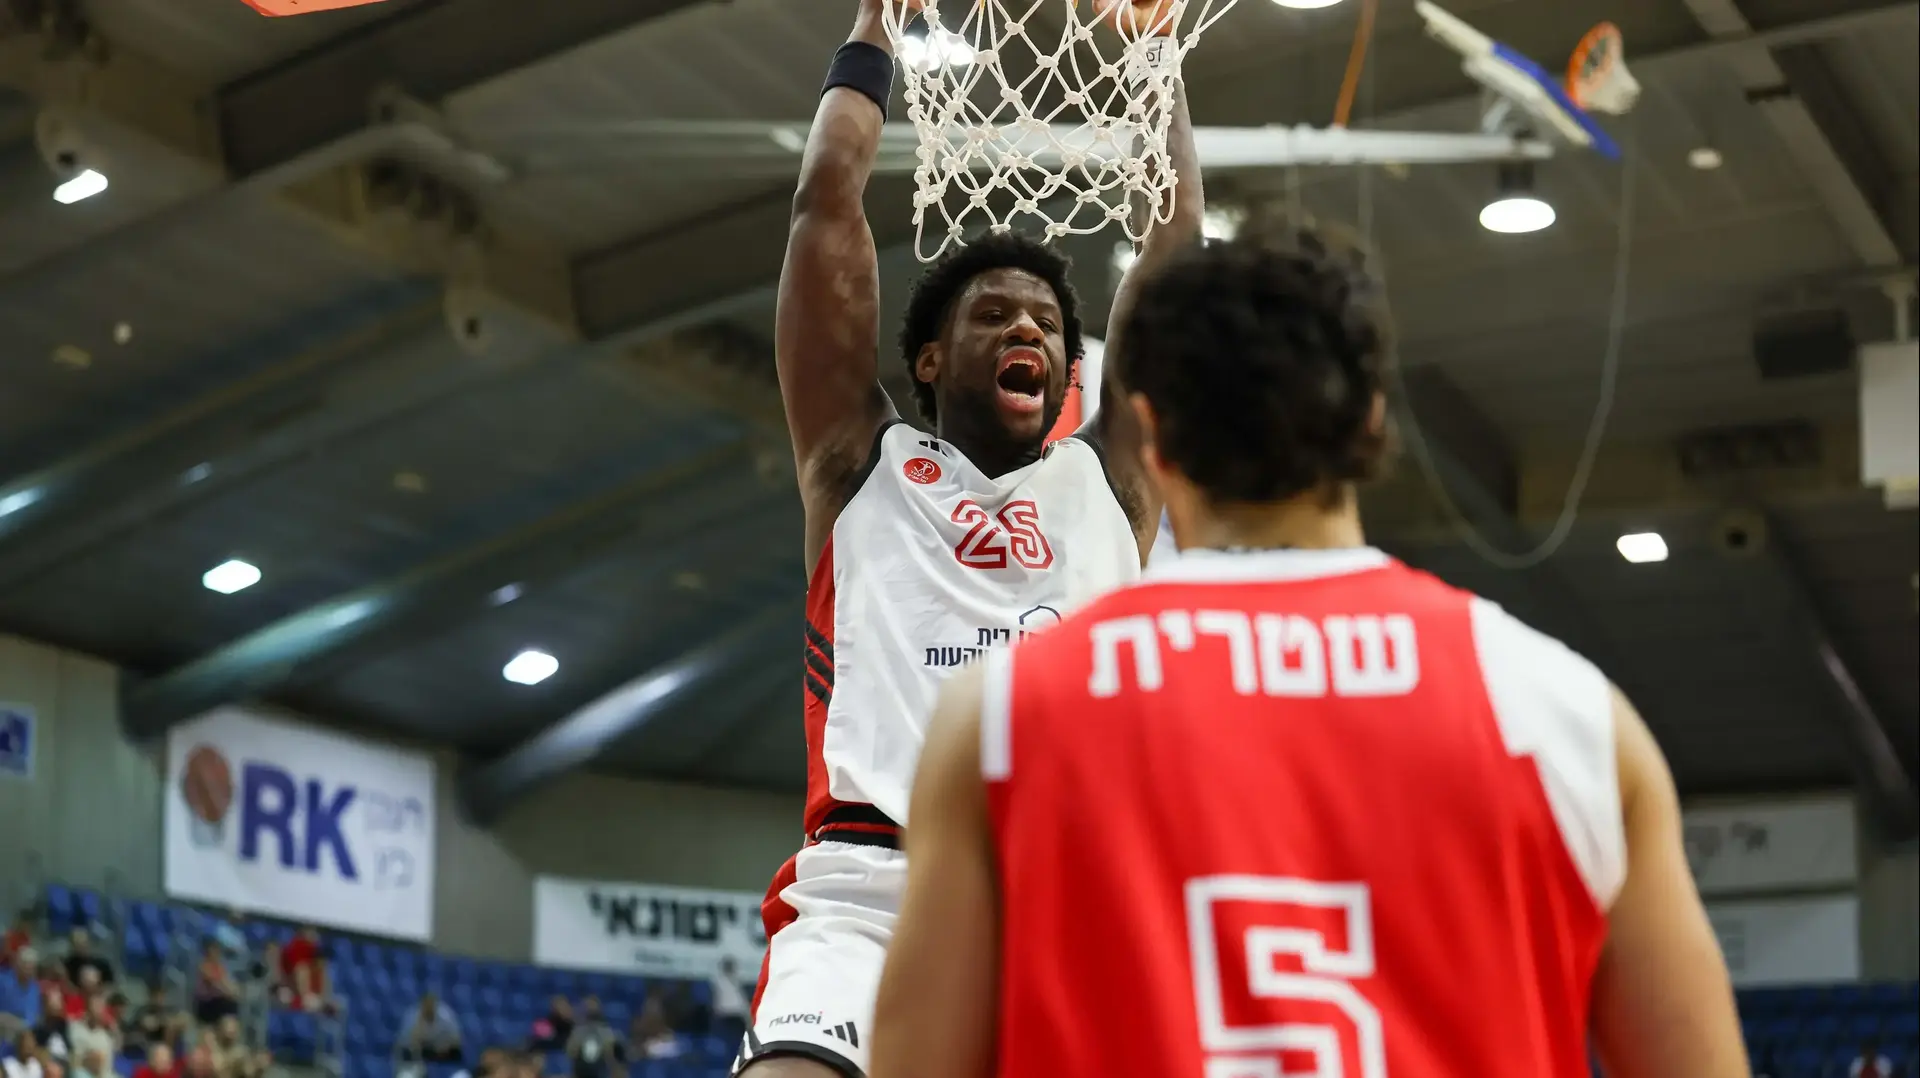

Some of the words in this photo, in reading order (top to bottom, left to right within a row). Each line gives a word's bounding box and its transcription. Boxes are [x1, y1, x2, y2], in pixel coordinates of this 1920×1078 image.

[951, 499, 1054, 570] 25
[1088, 609, 1420, 697] שטרית
[241, 761, 358, 882] RK
[769, 1010, 823, 1028] nuvei
[1184, 875, 1387, 1078] 5
